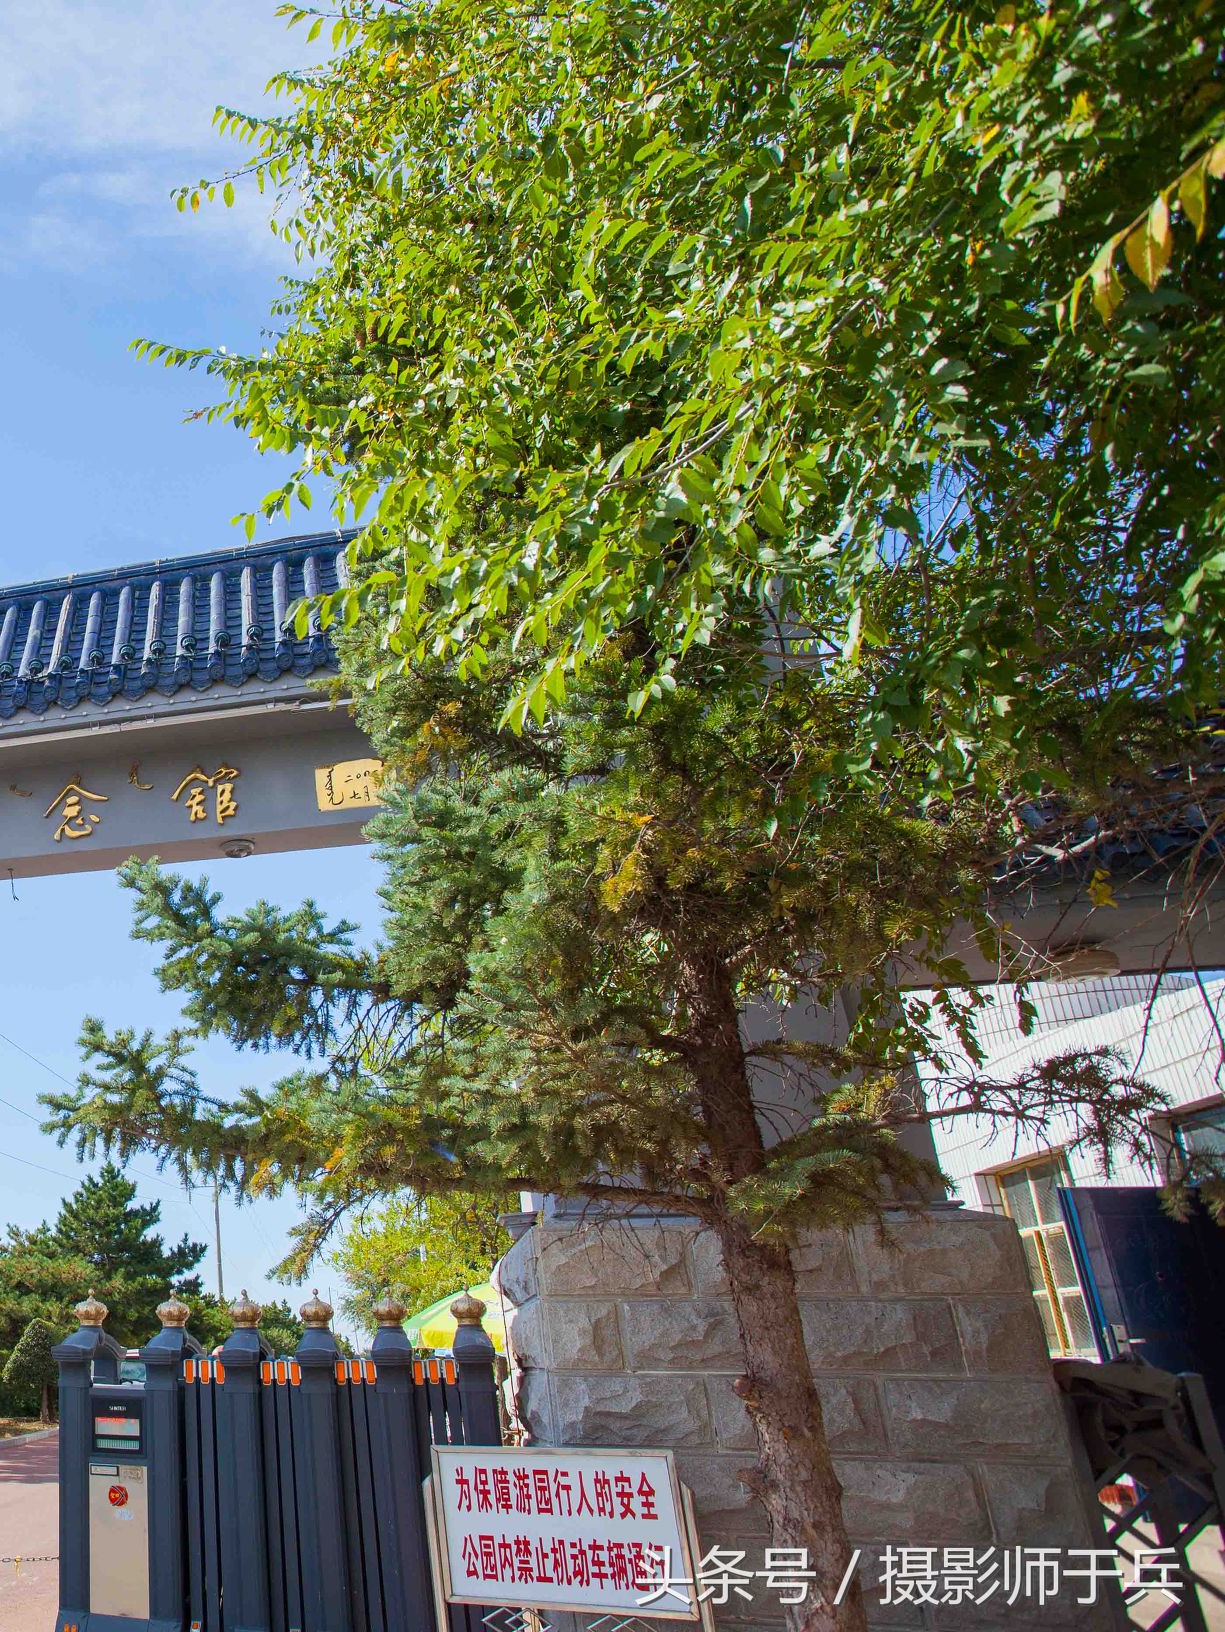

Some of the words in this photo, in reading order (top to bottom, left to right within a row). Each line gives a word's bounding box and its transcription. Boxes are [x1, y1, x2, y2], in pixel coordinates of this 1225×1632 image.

[455, 1466, 658, 1521] 为保障游园行人的安全
[461, 1534, 665, 1592] 公园内禁止机动车辆通行
